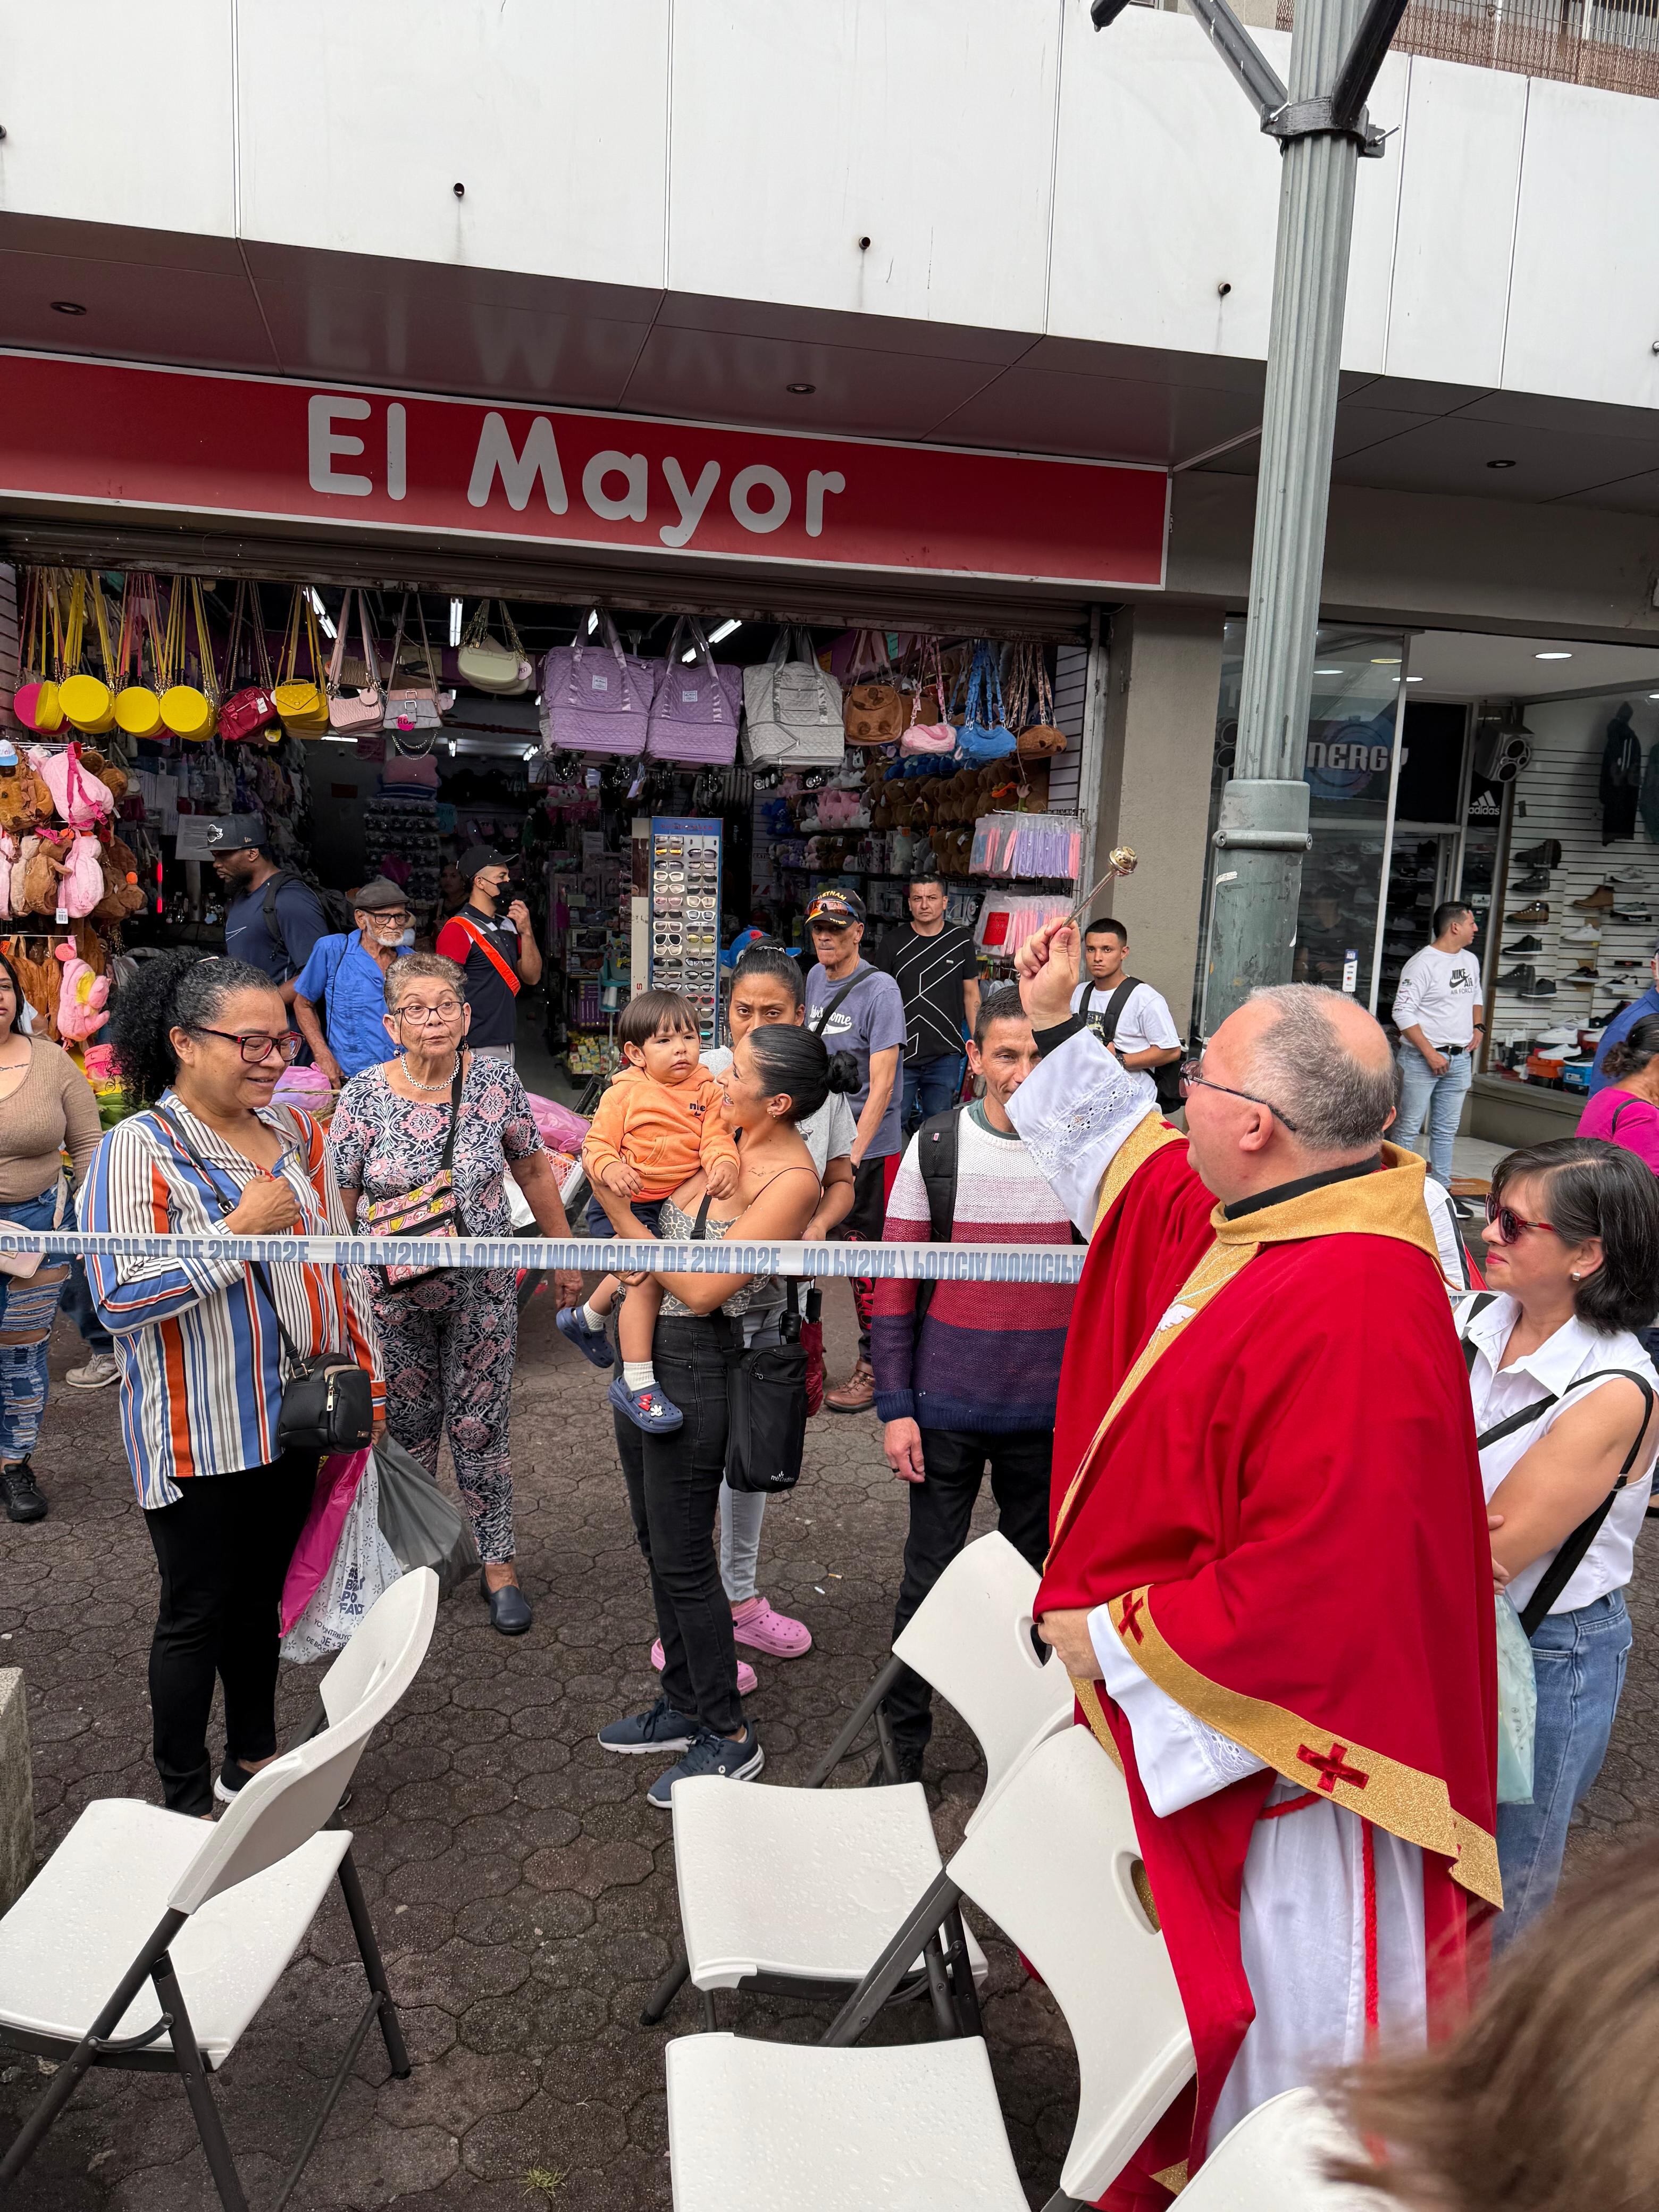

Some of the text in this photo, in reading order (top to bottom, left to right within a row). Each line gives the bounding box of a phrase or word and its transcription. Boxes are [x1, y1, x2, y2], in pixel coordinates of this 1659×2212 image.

[308, 395, 846, 548] El Mayor
[1307, 742, 1409, 773] NERGY
[1468, 806, 1500, 816] adidas
[1451, 968, 1466, 980] NIKE
[341, 1590, 358, 1603] PO
